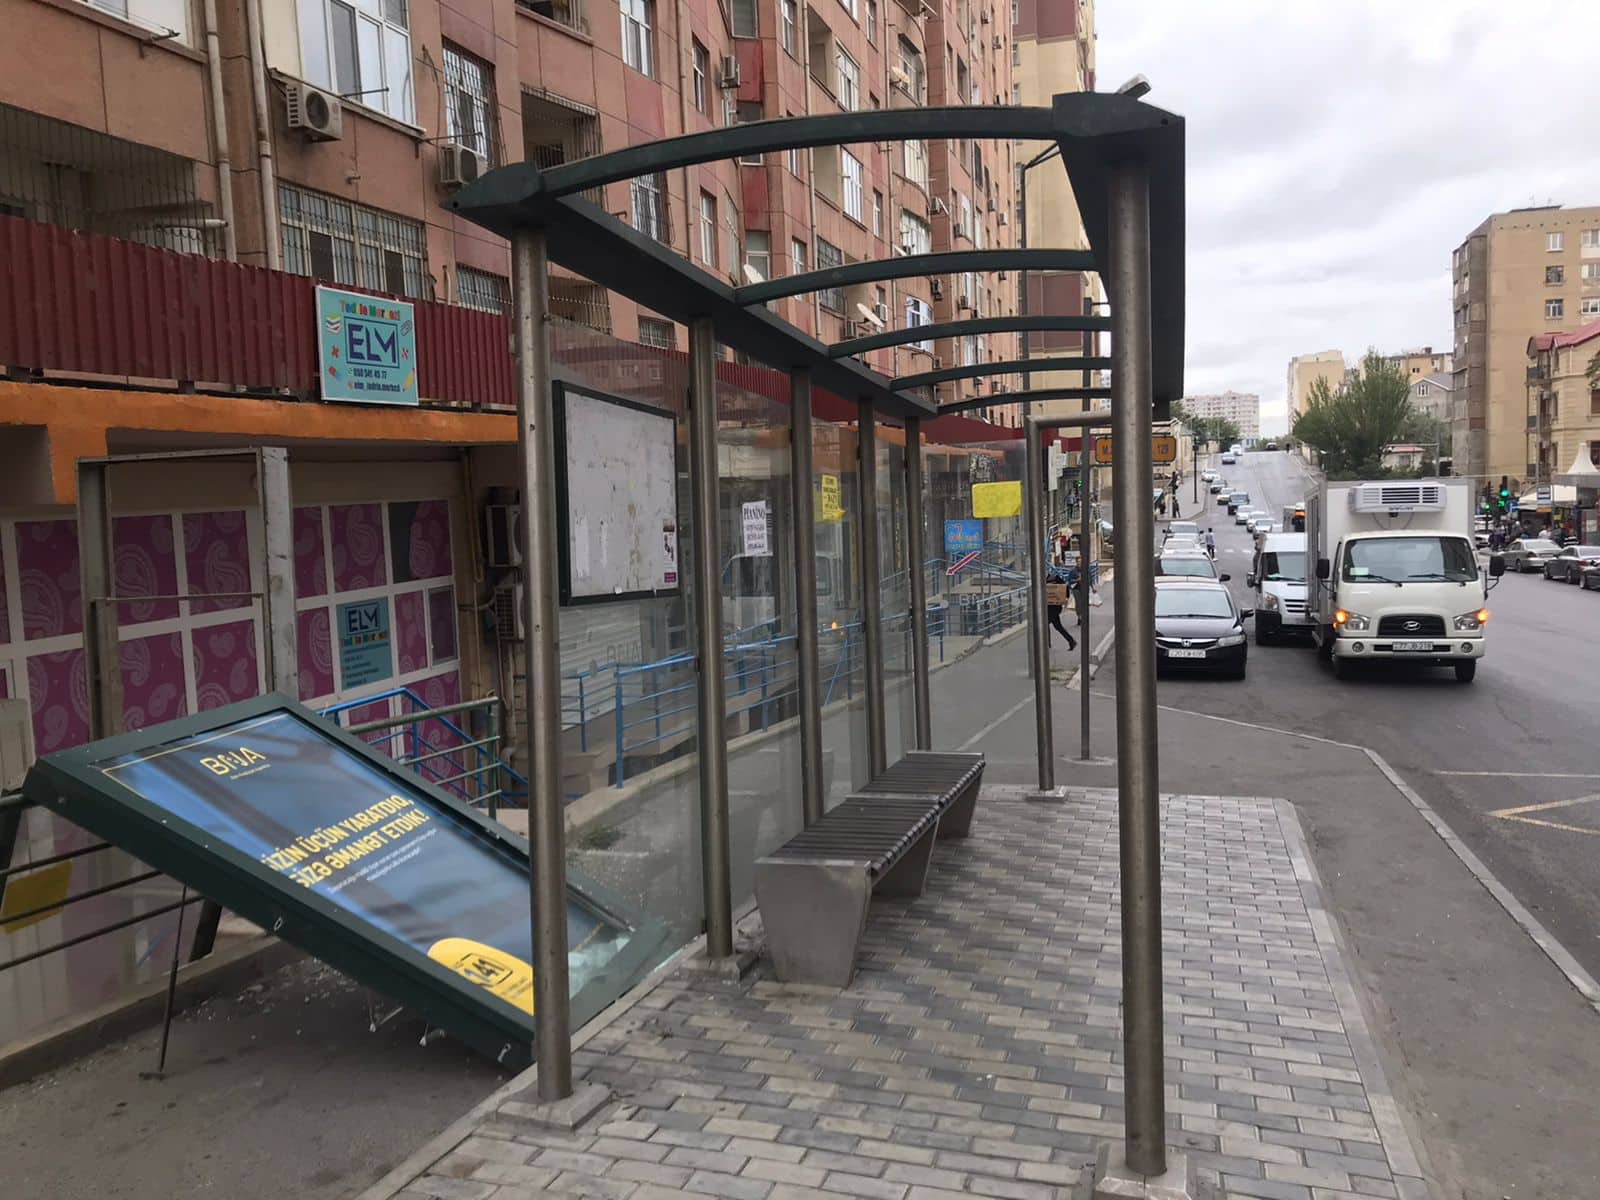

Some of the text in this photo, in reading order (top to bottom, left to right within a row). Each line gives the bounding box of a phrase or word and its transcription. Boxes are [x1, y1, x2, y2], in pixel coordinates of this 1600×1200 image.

[347, 323, 397, 364] ELM
[348, 608, 378, 633] ELM
[295, 825, 350, 853] ÜÇÜN
[324, 831, 389, 870] ƏMANƏT
[379, 808, 431, 840] ETDİK!
